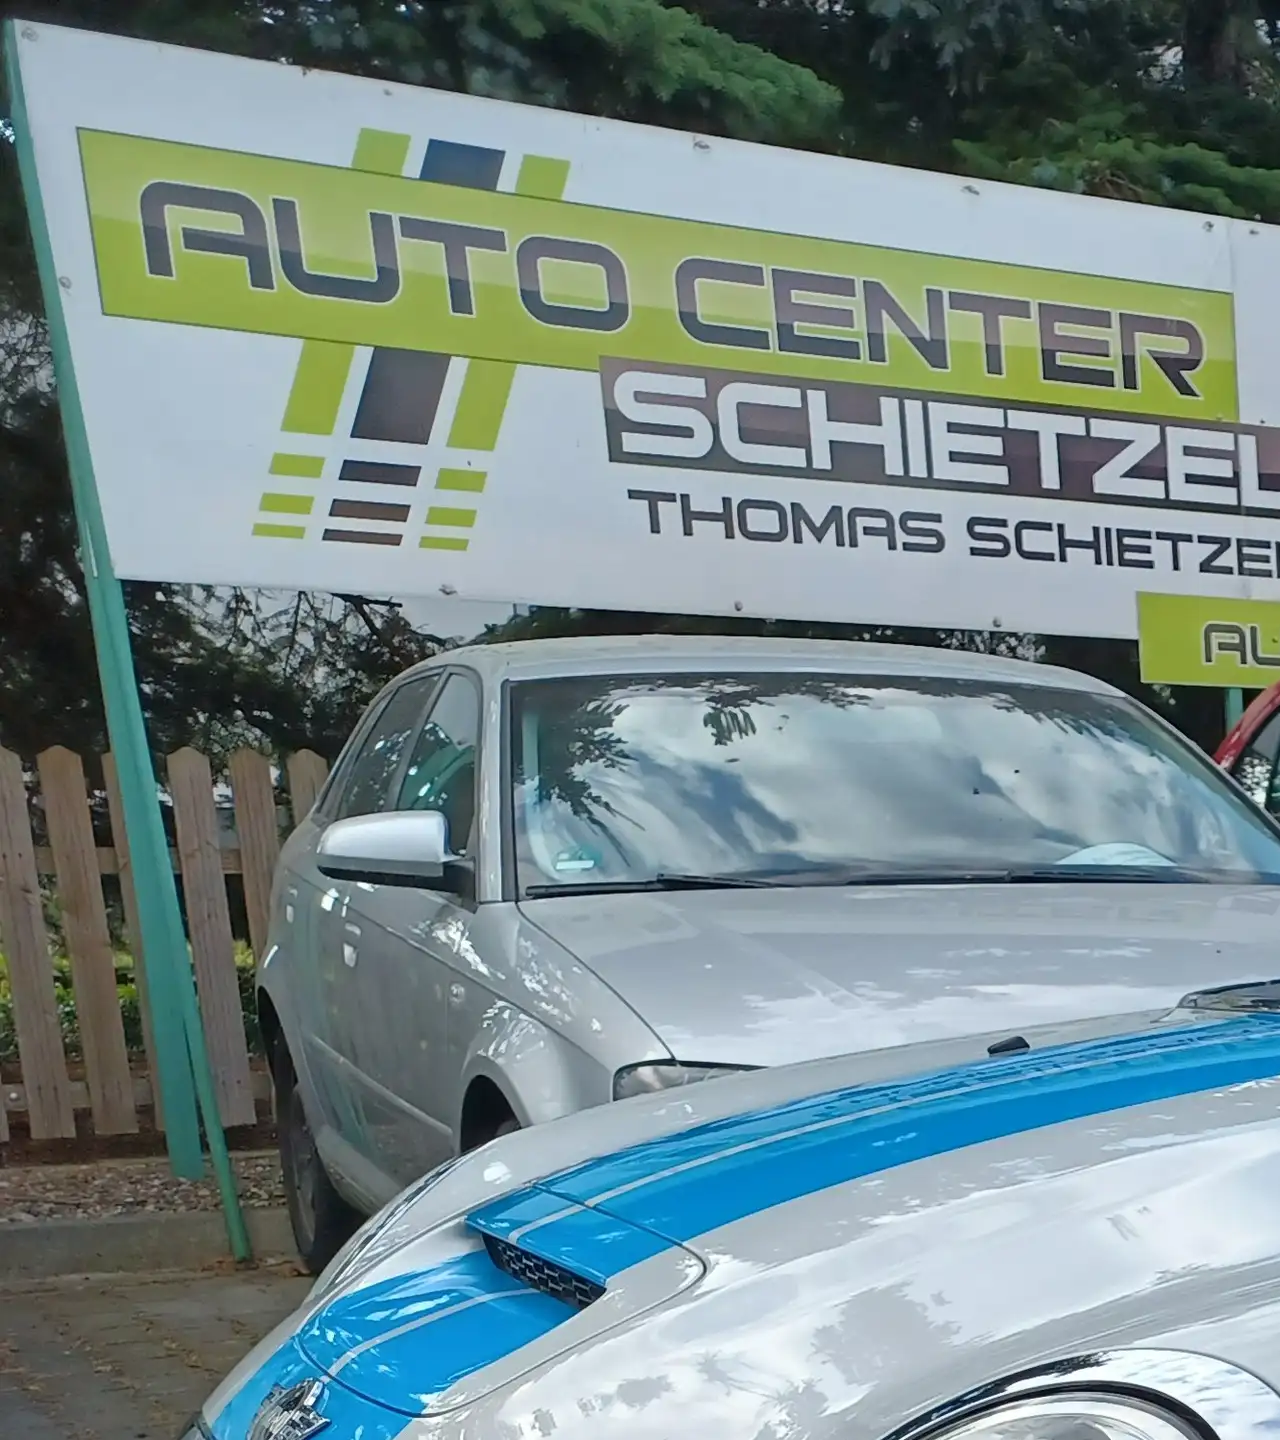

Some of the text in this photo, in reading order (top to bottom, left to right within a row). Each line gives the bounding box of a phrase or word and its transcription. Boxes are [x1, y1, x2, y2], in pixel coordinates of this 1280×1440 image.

[140, 181, 1205, 397] AUTO CENTER
[627, 489, 945, 554] THOMAS
